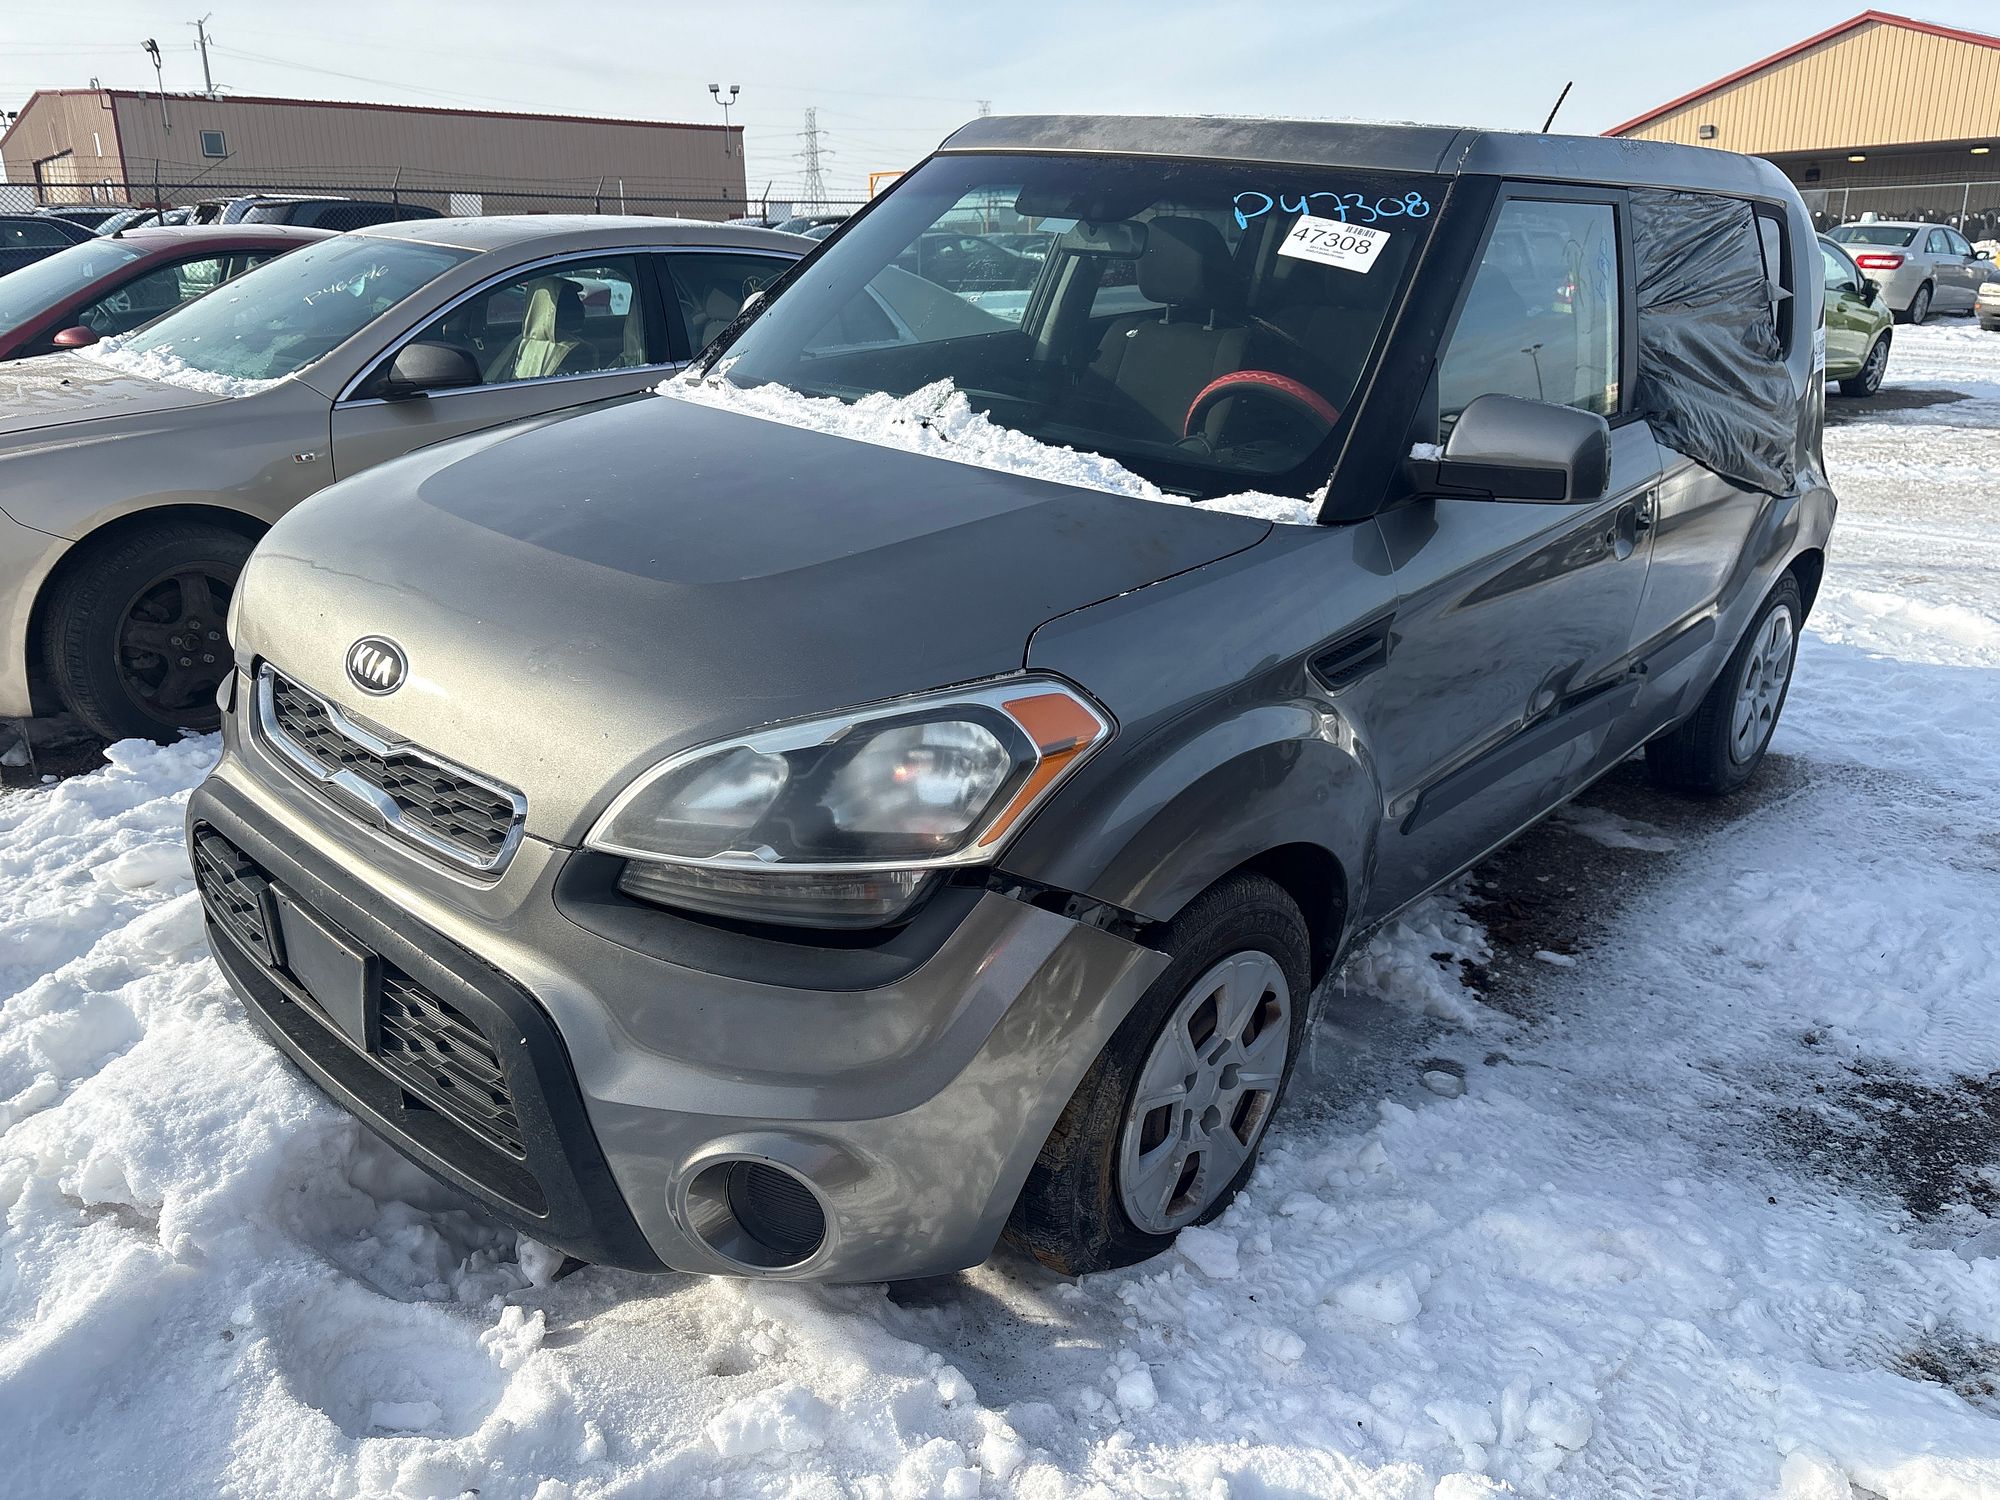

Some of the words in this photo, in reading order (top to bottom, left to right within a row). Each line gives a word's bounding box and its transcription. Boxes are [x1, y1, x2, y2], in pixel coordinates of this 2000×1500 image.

[1233, 191, 1430, 230] P47308
[1293, 227, 1372, 254] 47308
[352, 643, 393, 687] KIA
